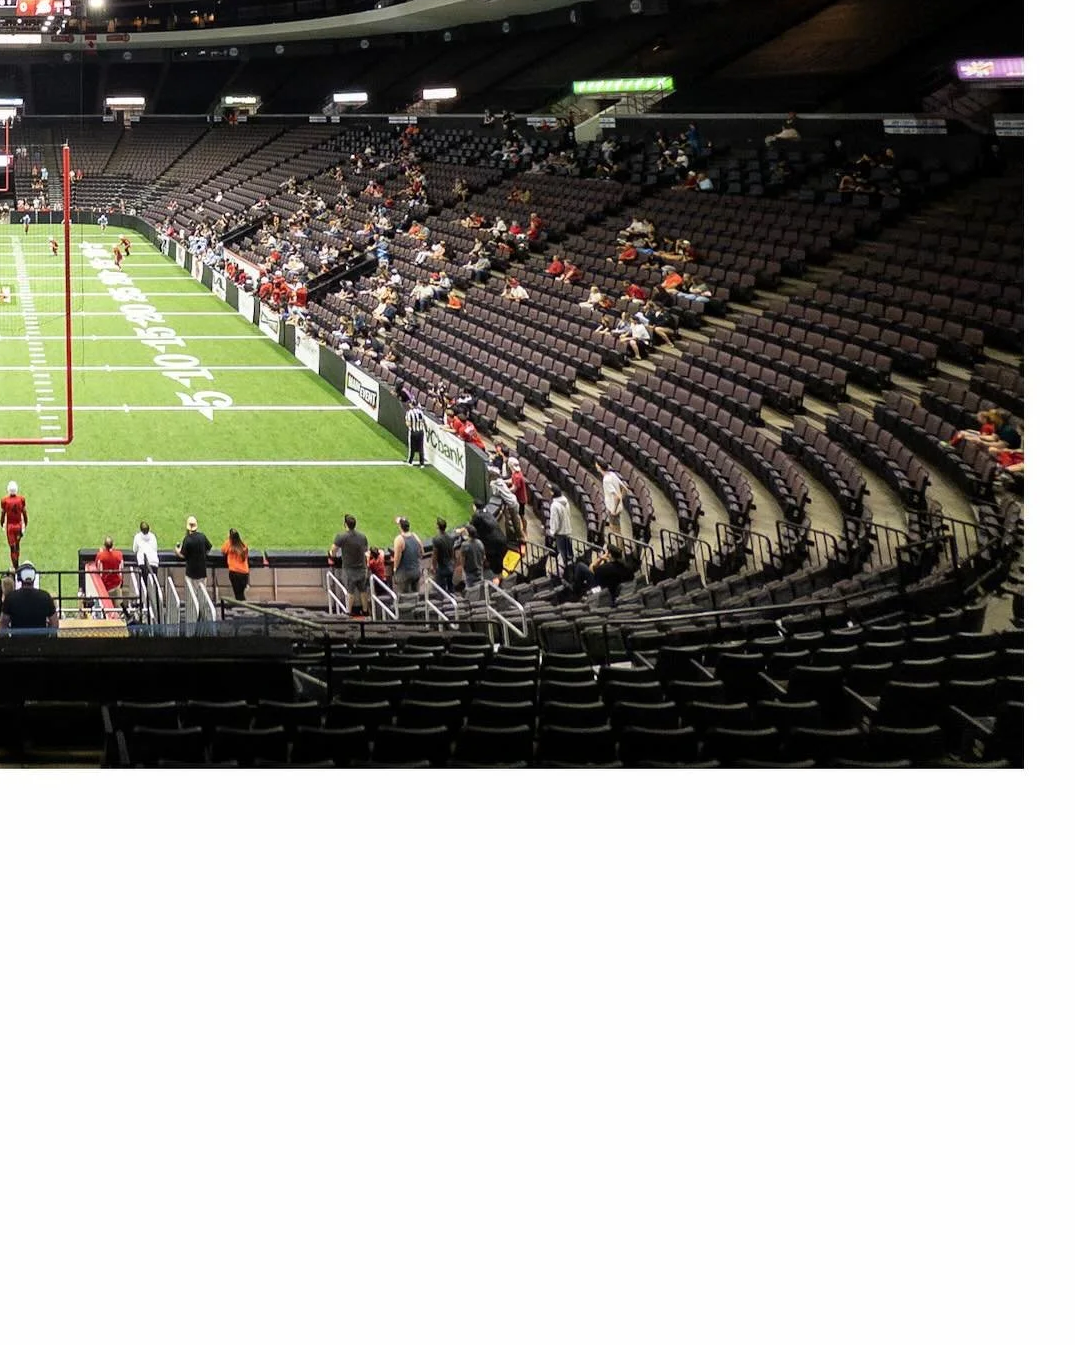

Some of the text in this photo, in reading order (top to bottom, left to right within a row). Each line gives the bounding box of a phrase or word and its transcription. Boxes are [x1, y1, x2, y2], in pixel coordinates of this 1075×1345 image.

[133, 327, 187, 347] 15
[153, 354, 214, 380] 10
[175, 391, 233, 408] 5
[359, 387, 377, 408] EVENT
